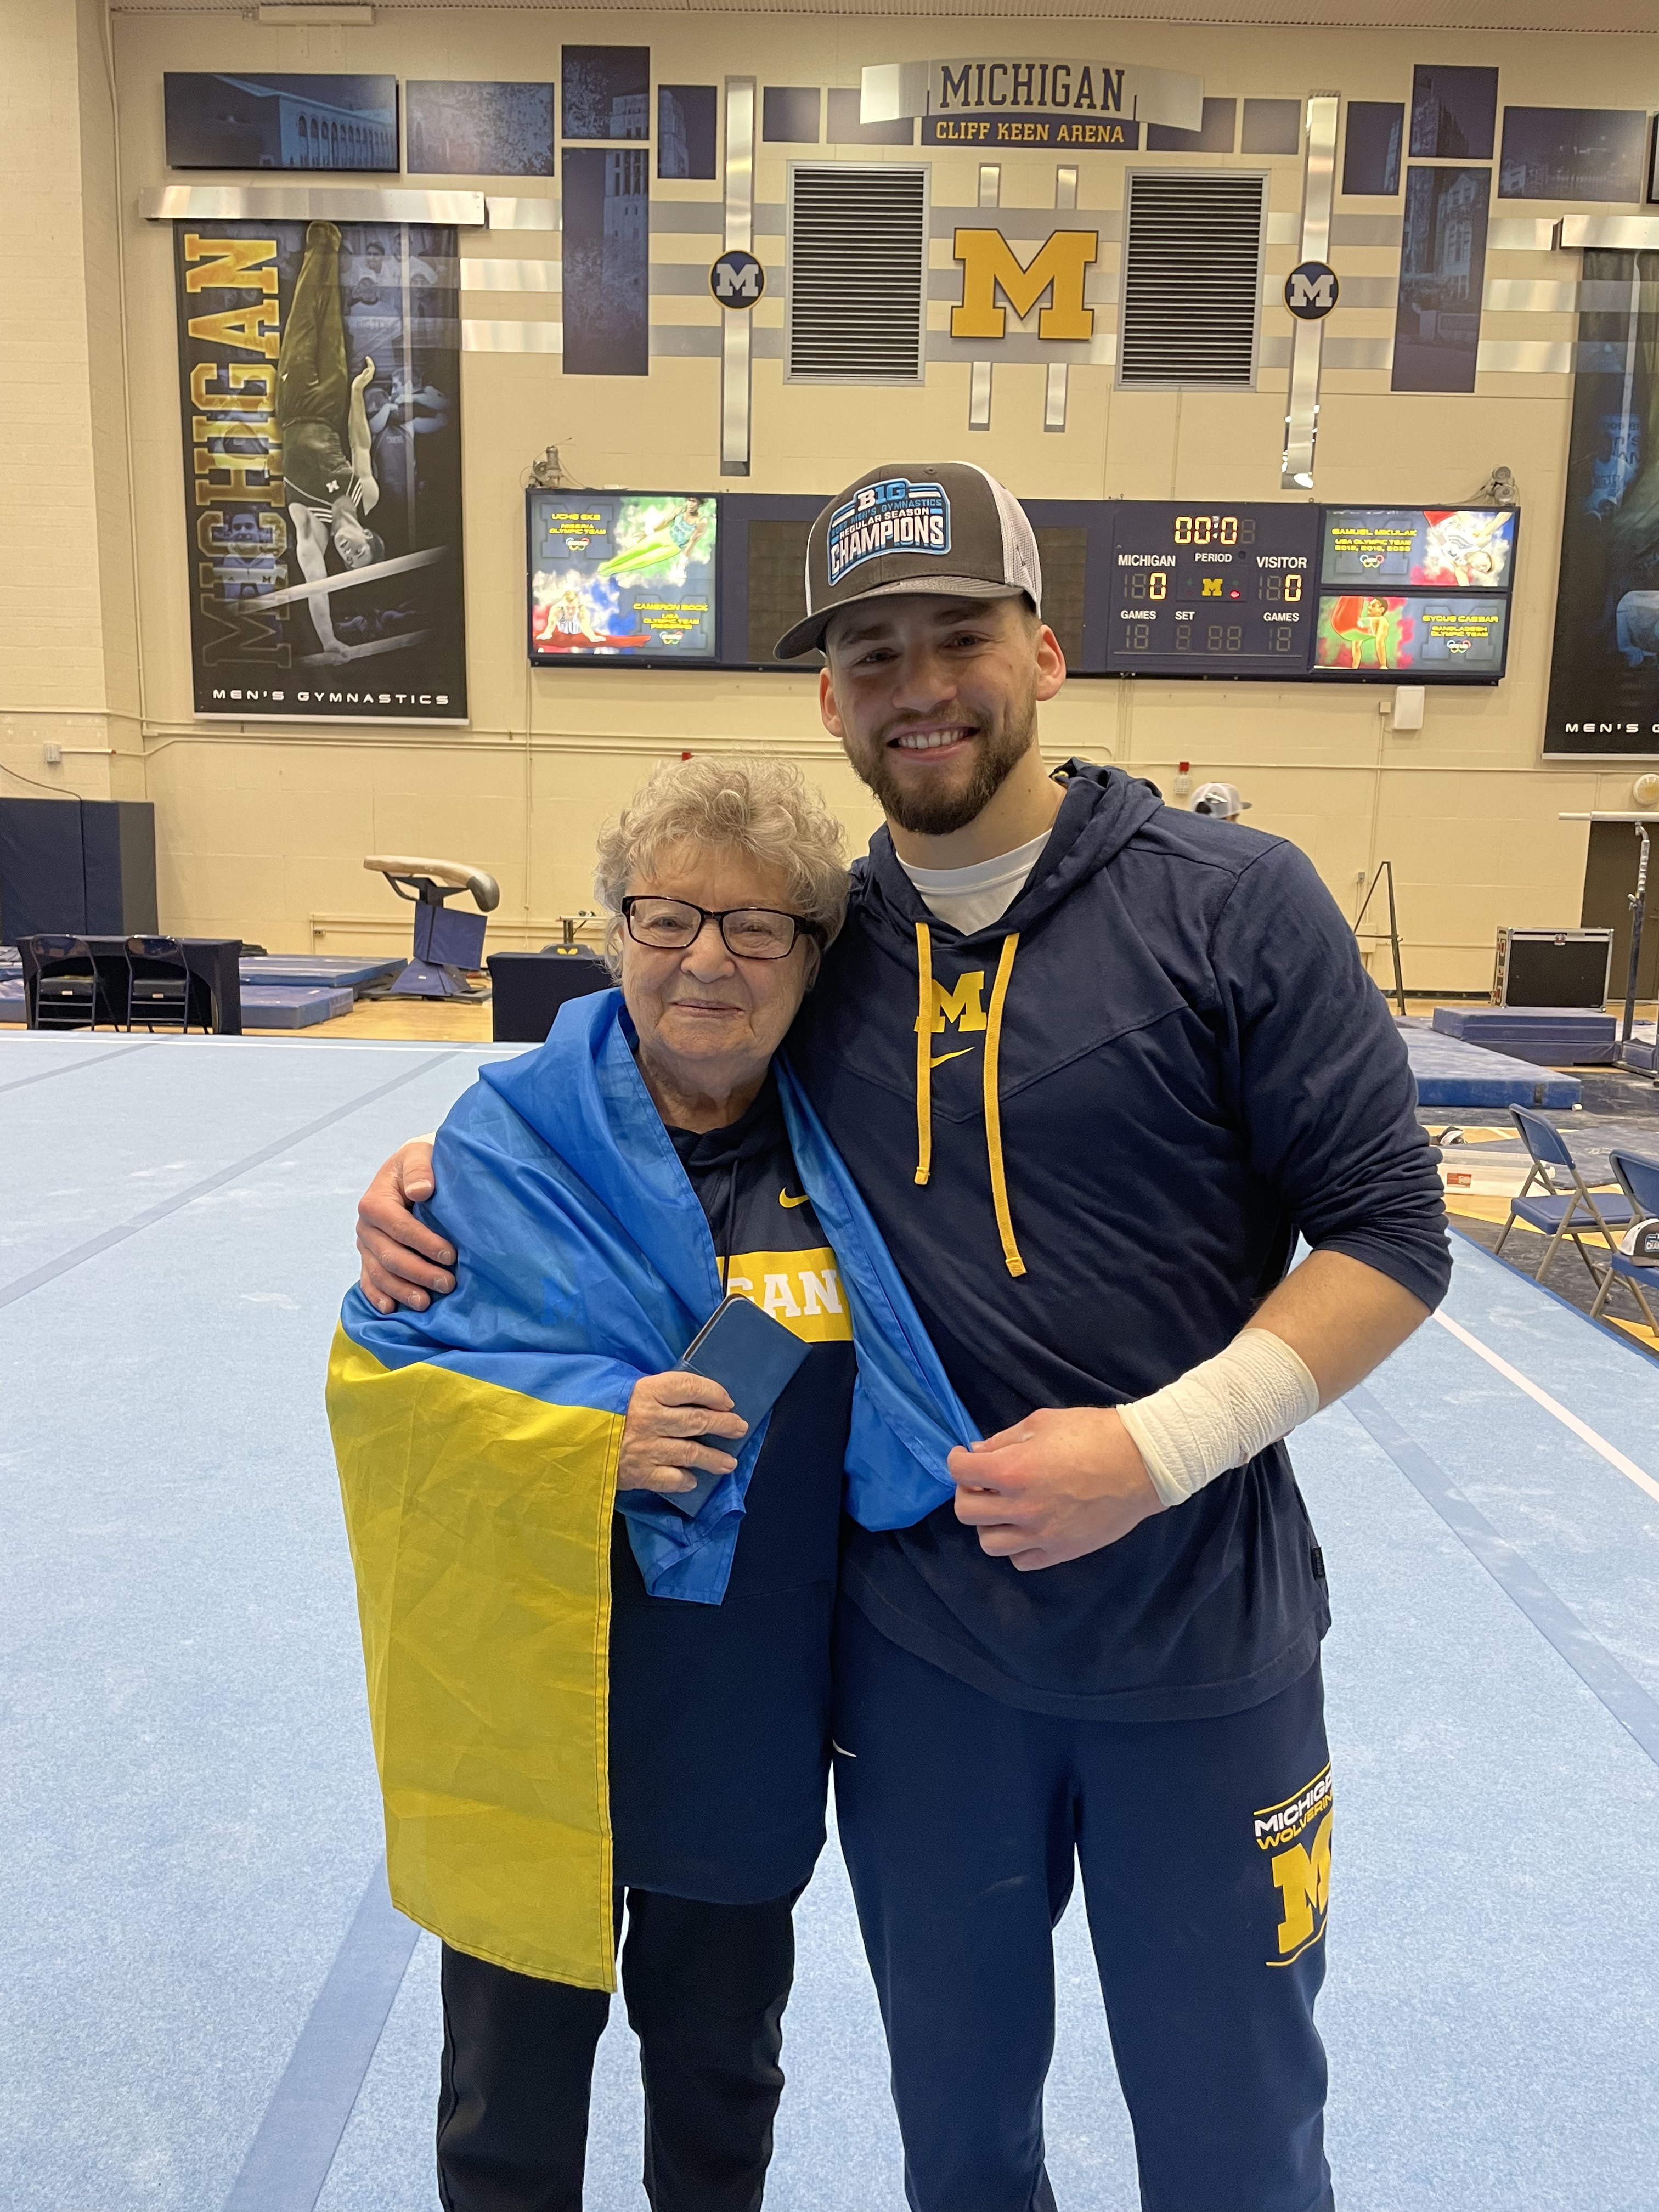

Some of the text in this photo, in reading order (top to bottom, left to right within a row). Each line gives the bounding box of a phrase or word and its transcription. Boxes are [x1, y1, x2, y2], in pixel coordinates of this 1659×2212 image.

[940, 63, 1125, 112] MICHIGAN
[936, 121, 1125, 143] CLIFF KEEN ARENA
[715, 263, 759, 297] M
[950, 227, 1099, 341] M
[1289, 274, 1335, 307] M
[184, 233, 292, 669] MICHIGAN
[851, 507, 877, 523] MEN'S
[881, 499, 943, 513] GYMNASTICS
[839, 507, 929, 540] REGULAR SEASON
[830, 515, 944, 577] CHAMPIONS
[1118, 555, 1176, 567] MICHIGAN
[1194, 552, 1233, 563] PERIOD
[1256, 556, 1308, 568] VISITOR
[1201, 578, 1223, 597] M
[1120, 610, 1156, 620] GAMES
[1175, 611, 1195, 620] SET
[1263, 612, 1300, 622] GAMES
[212, 689, 449, 705] MEN'S GYMNASTICS
[1565, 723, 1639, 733] MEN'S
[913, 970, 987, 1033] M
